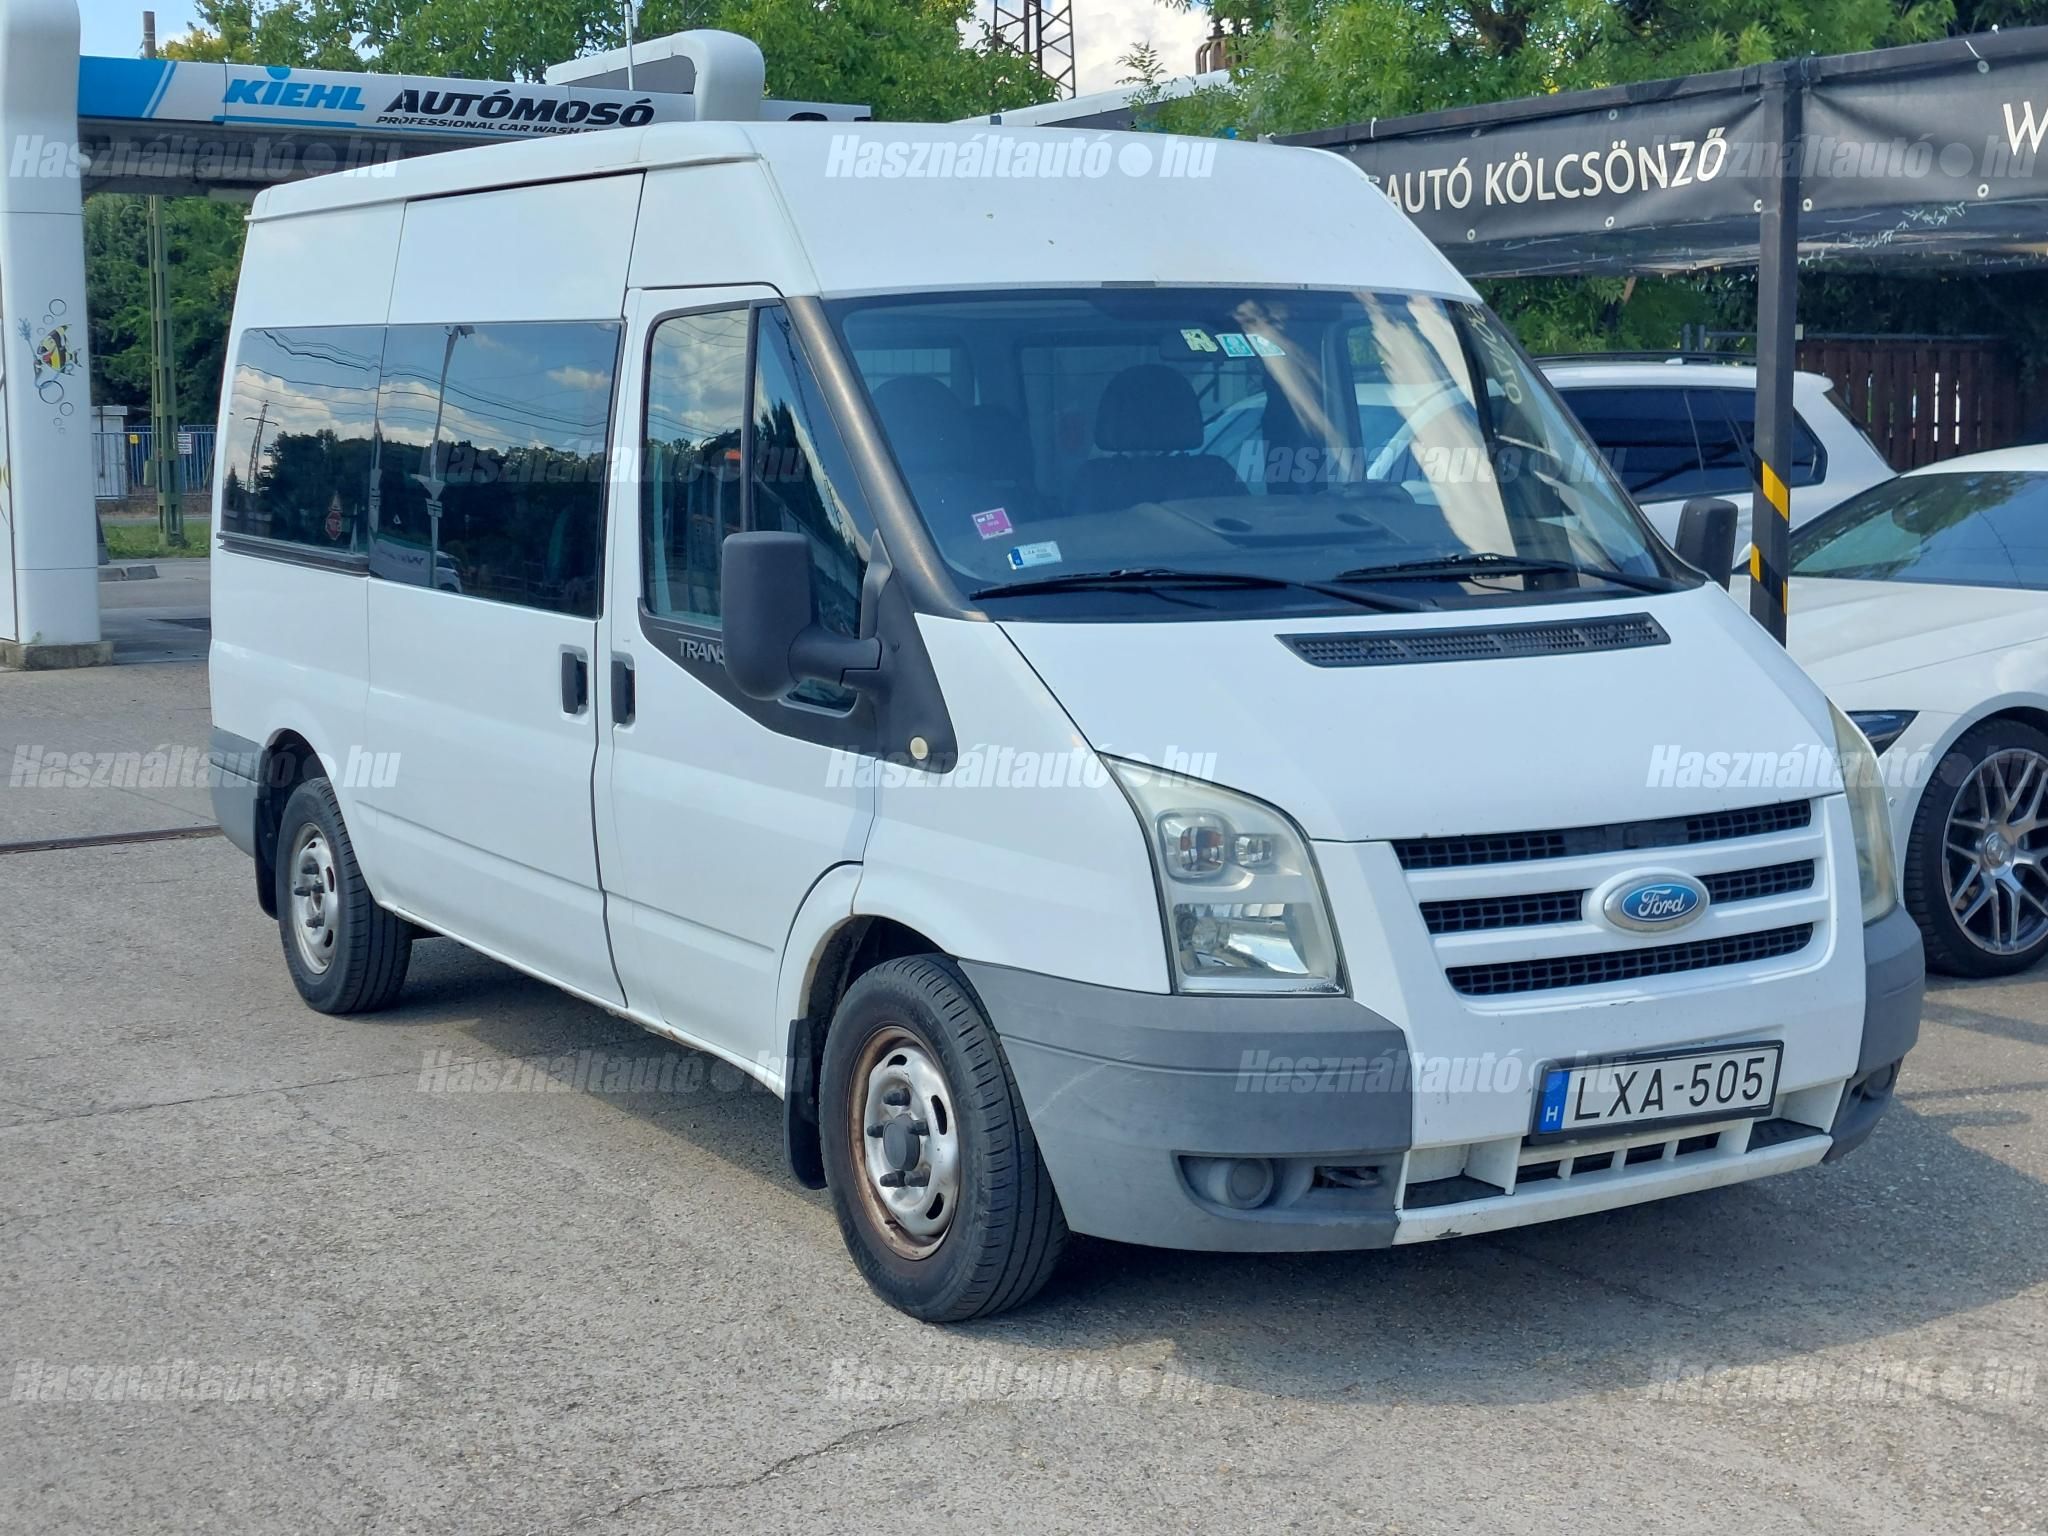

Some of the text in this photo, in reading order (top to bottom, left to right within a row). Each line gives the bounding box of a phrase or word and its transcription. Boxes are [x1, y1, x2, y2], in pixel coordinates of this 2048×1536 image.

[375, 115, 496, 131] PROFESSIONAL
[497, 122, 528, 133] CAR
[383, 88, 654, 127] AUTÓMOSÓ
[1386, 127, 1726, 214] AUTÓ KÖLCSÖNZŐ
[1638, 888, 1685, 917] Ford
[1574, 1057, 1765, 1121] LXA-505
[1545, 1105, 1559, 1123] H
